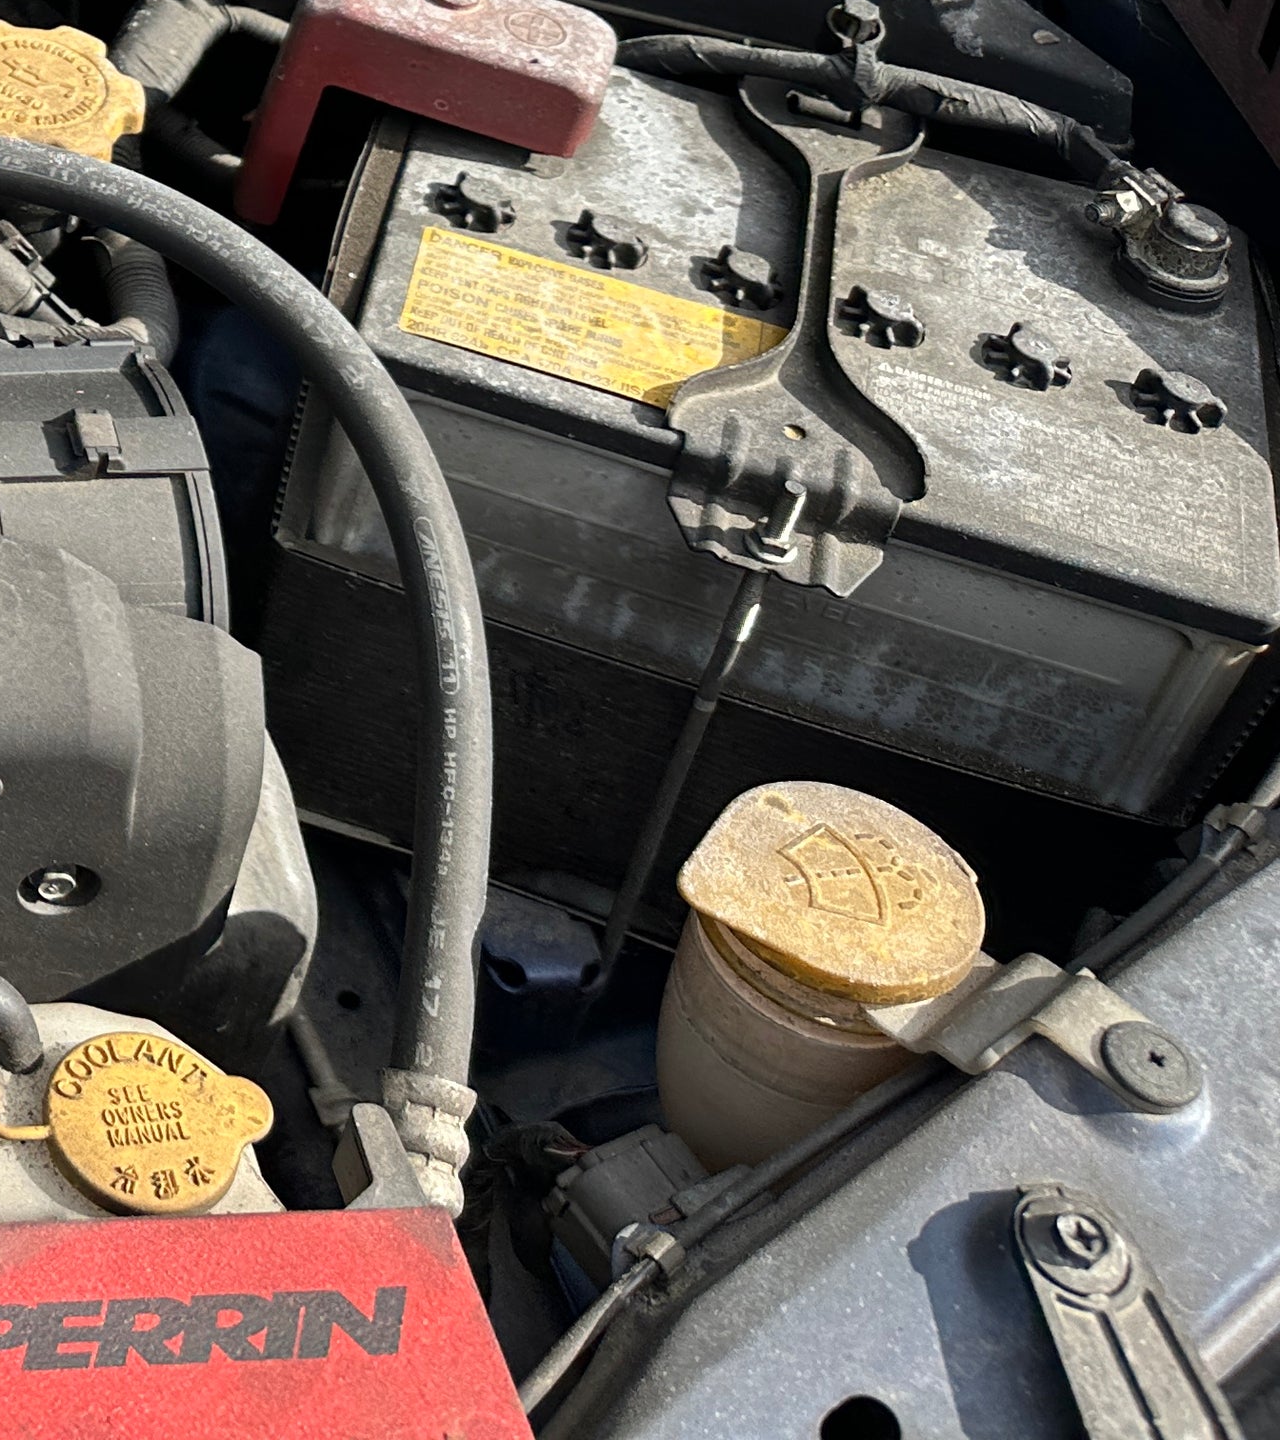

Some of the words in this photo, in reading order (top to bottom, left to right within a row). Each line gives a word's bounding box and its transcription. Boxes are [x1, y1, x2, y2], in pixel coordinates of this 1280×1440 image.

[428, 229, 503, 261] DANGER
[417, 278, 490, 308] POISON
[52, 1038, 209, 1101] COOLANT
[106, 1083, 152, 1106] SEE
[100, 1100, 184, 1128] OWNERS
[105, 1121, 192, 1149] MANUAL
